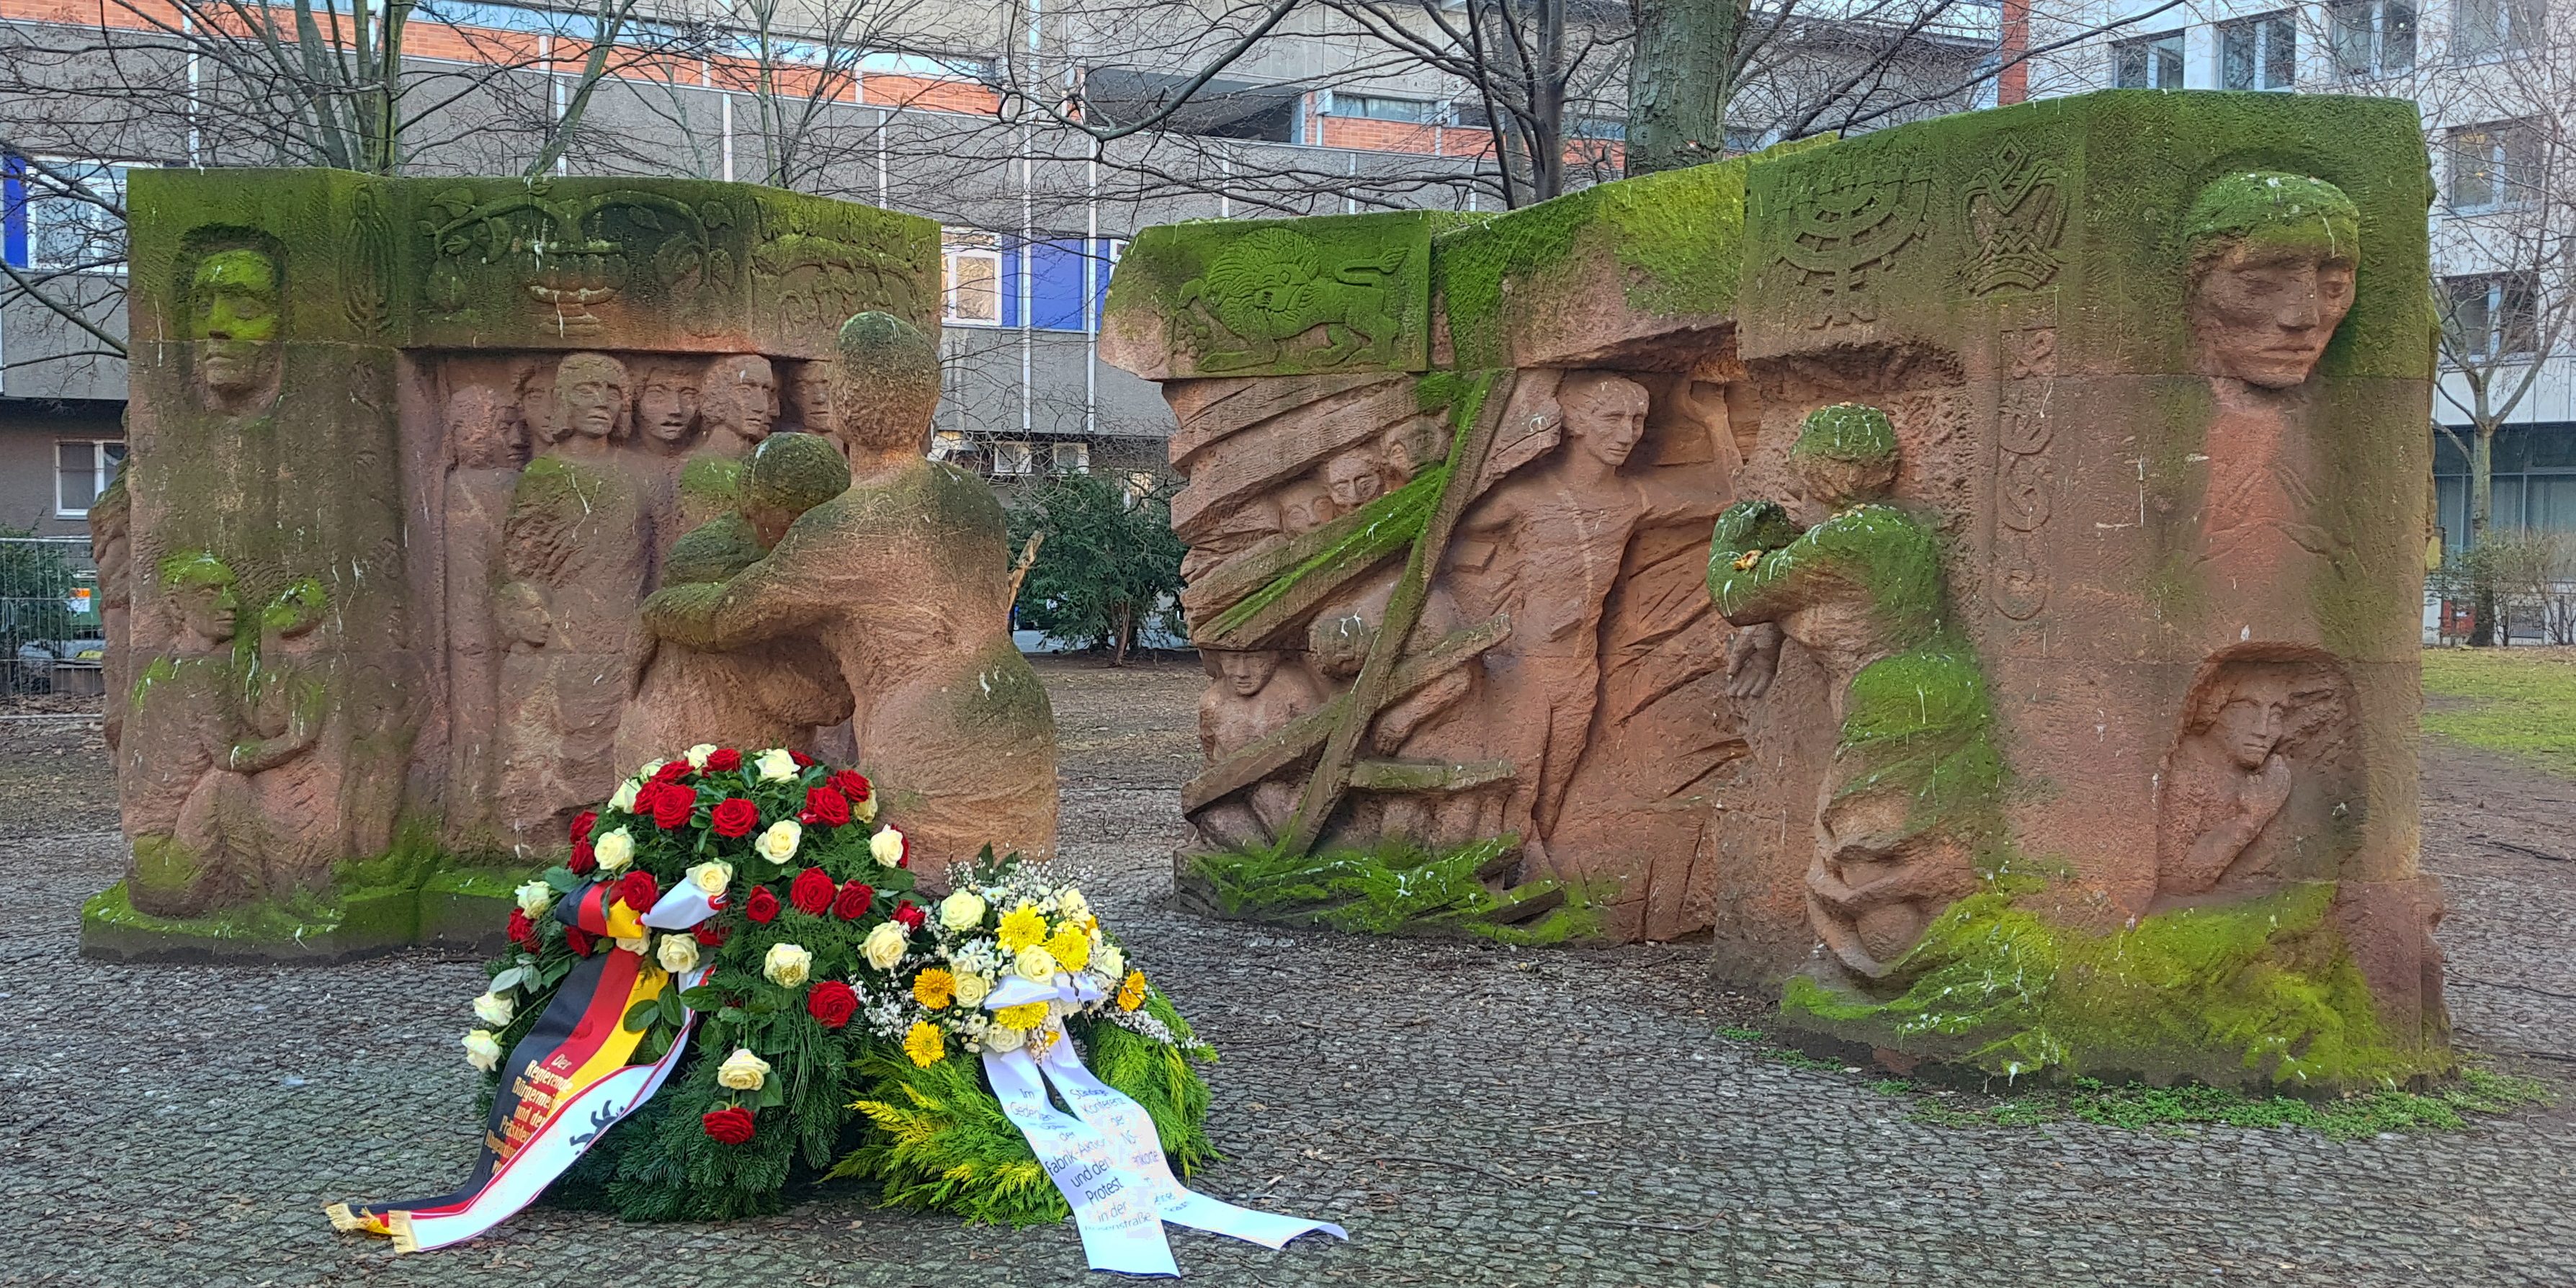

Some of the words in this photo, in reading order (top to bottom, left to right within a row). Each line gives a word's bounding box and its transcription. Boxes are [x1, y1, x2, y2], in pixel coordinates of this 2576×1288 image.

[550, 1053, 573, 1070] Der
[524, 1060, 574, 1094] Regierende
[1019, 1088, 1036, 1100] Im
[513, 1105, 532, 1123] und
[498, 1115, 534, 1144] Präsiden
[1070, 1164, 1094, 1188] und
[1085, 1176, 1124, 1206] Protest
[1097, 1210, 1109, 1223] in
[1109, 1201, 1127, 1218] der
